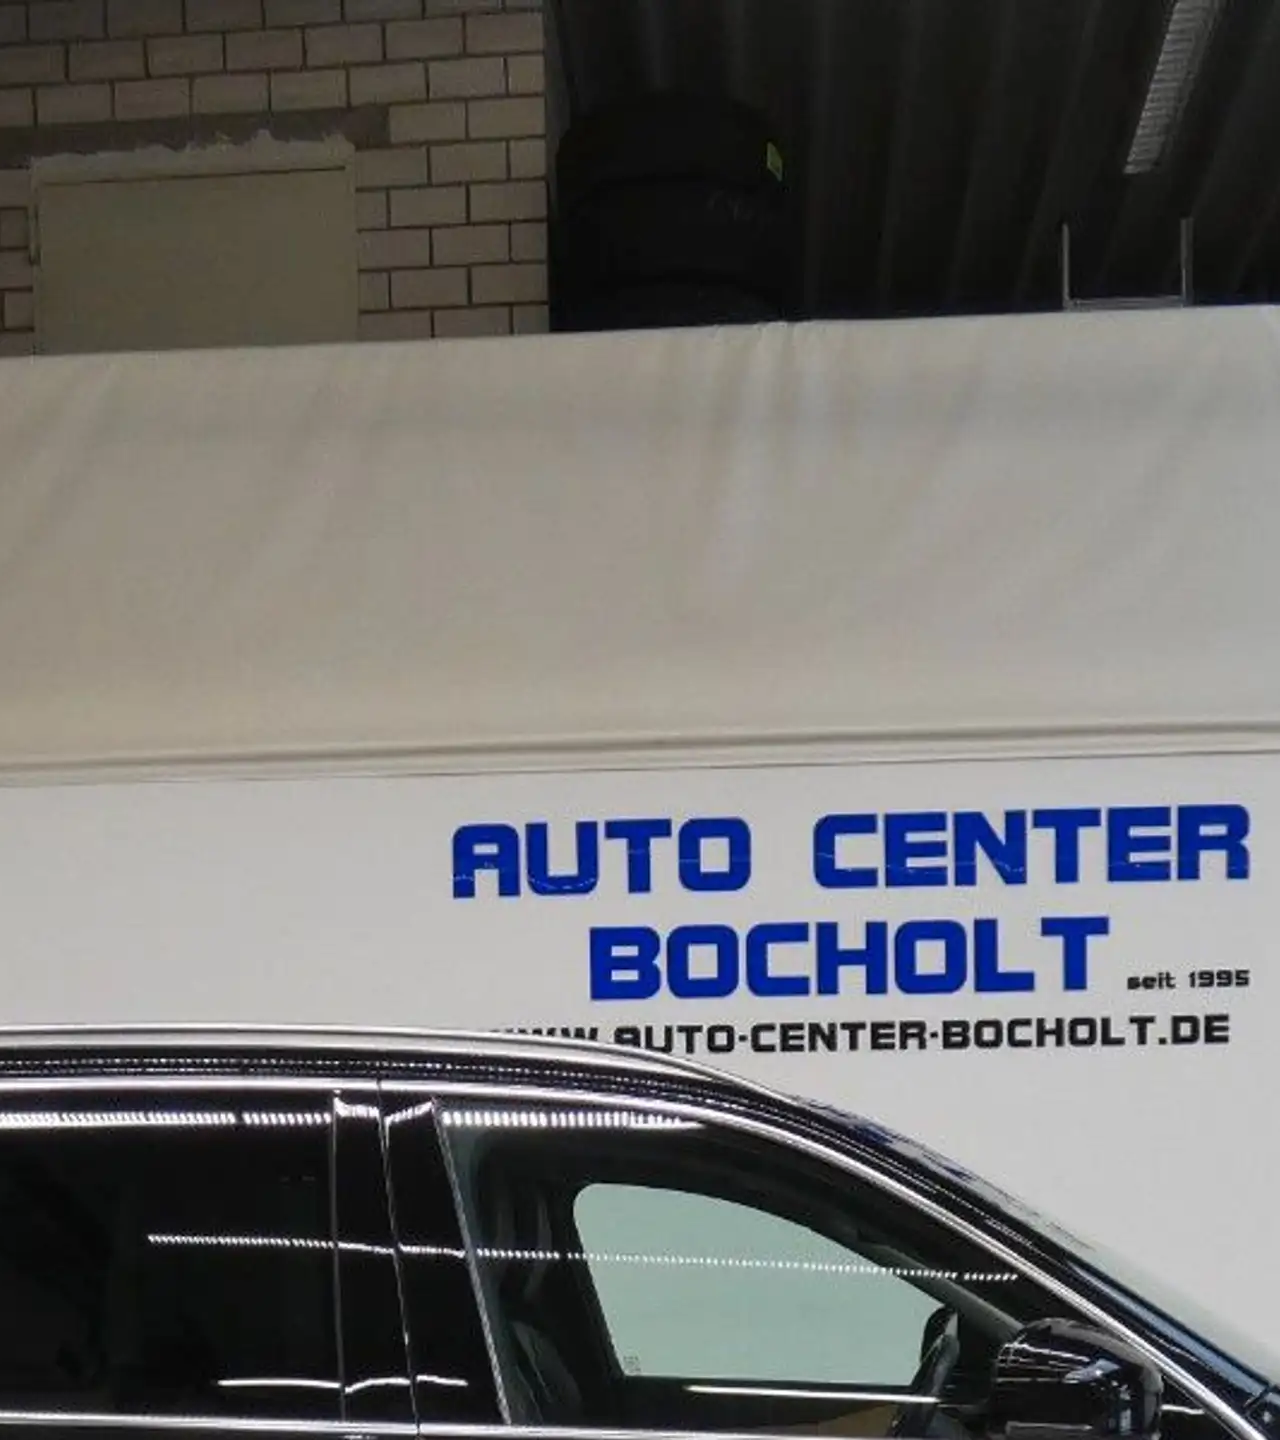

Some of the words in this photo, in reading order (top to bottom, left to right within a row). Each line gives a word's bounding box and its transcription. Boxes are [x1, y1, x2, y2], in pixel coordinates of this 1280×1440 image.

[452, 817, 752, 899] AUTO
[813, 804, 1250, 889] CENTER
[589, 916, 1109, 1001] BOCHOLT
[1127, 971, 1176, 990] seit
[1188, 969, 1250, 988] 1995
